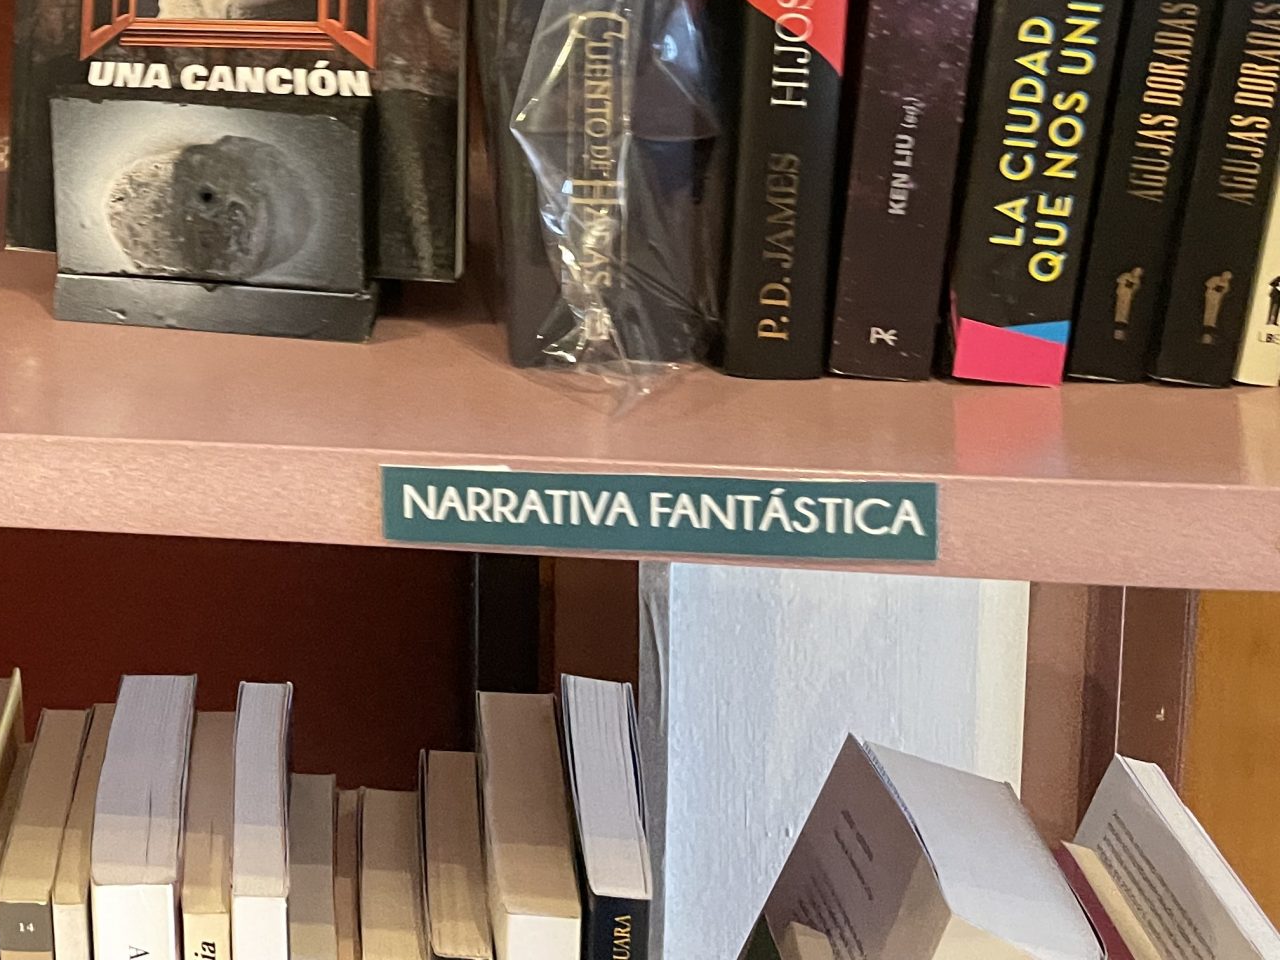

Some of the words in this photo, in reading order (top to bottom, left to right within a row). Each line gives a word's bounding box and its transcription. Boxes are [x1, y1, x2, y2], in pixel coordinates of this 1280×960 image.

[88, 61, 171, 89] UNA
[180, 60, 372, 97] CANCIÓN
[1143, 2, 1200, 107] DORADAS
[999, 16, 1055, 181] CIUDAD
[893, 134, 915, 167] LIU
[1043, 91, 1089, 179] NOS
[1128, 112, 1179, 203] AGUJAS
[1218, 114, 1271, 206] AGUJAS
[762, 153, 800, 269] JAMES
[888, 172, 910, 215] KEN
[989, 198, 1028, 246] LA
[1028, 194, 1073, 282] QUE
[759, 275, 793, 308] D.
[757, 315, 789, 340] P.
[402, 483, 639, 527] NARRATIVA
[649, 488, 926, 537] FANTÁSTICA
[19, 923, 34, 932] 14
